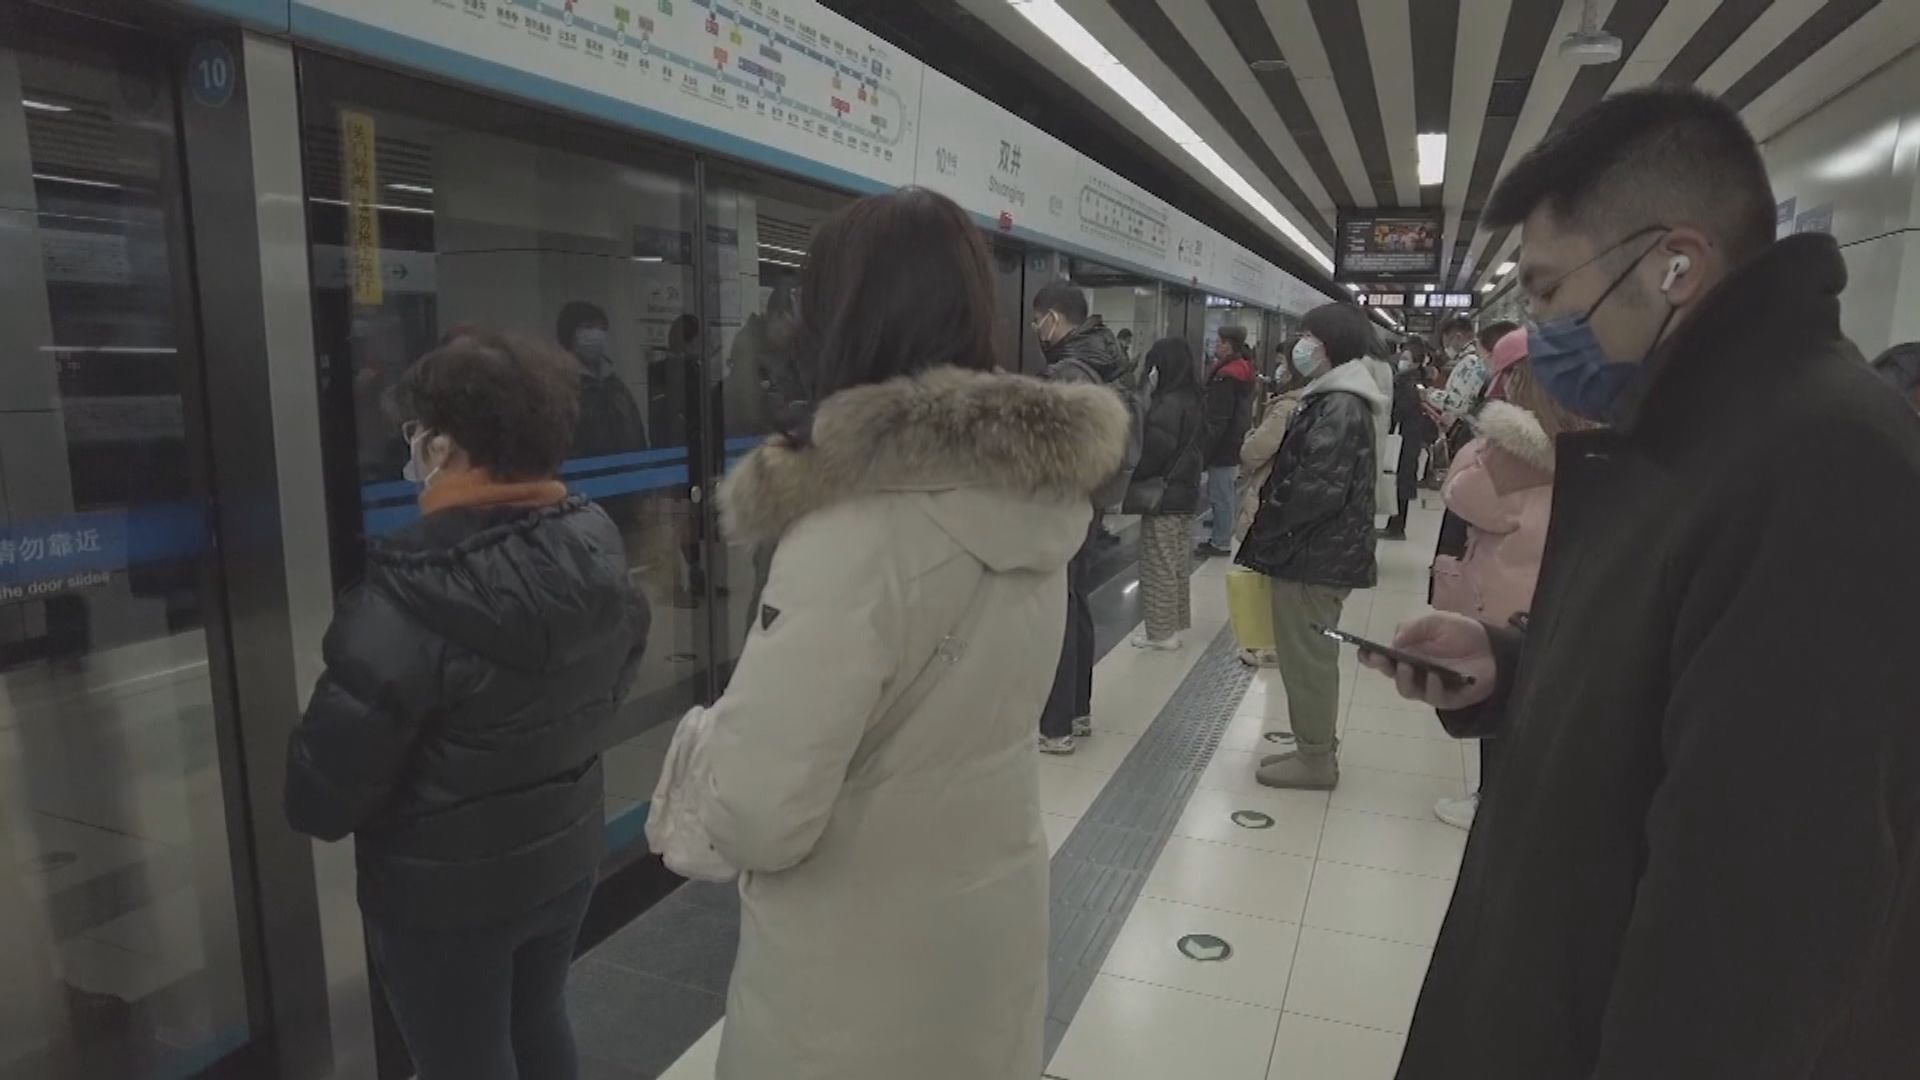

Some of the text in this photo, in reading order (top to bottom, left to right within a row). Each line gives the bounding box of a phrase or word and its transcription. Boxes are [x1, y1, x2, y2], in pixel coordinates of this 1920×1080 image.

[198, 57, 227, 89] 10
[997, 140, 1022, 177] 双井
[28, 578, 63, 594] door
[67, 571, 110, 588] slides
